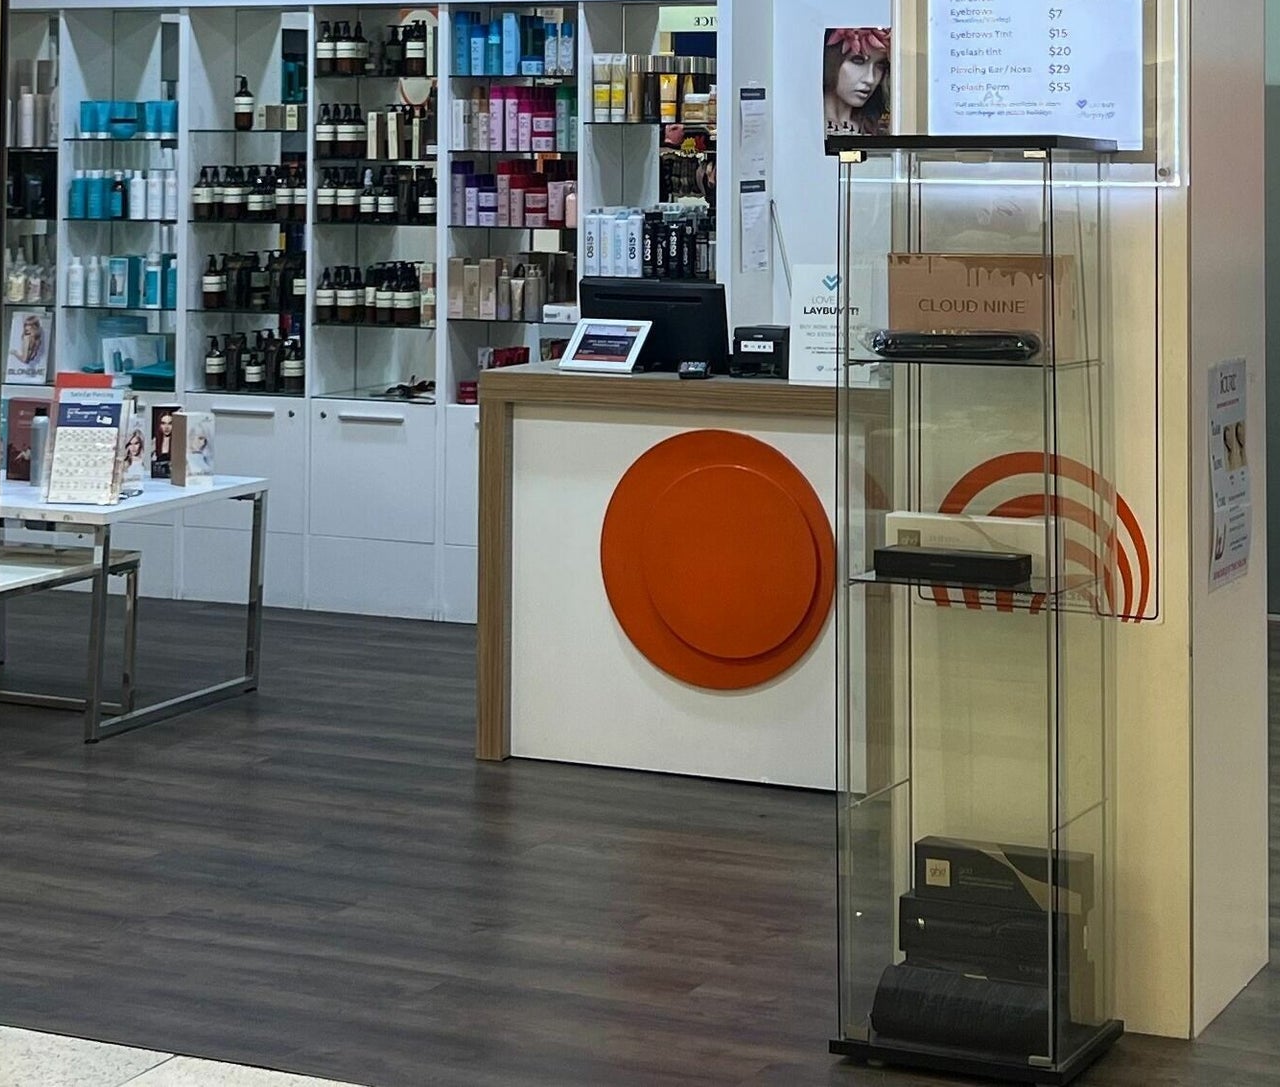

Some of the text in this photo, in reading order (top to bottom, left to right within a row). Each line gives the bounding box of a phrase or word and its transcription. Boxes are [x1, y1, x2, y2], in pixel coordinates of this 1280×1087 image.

[1048, 7, 1063, 20] $7
[950, 31, 993, 40] Eyebrows
[1048, 28, 1068, 39] $15
[950, 48, 984, 57] Eyelash
[1048, 45, 1072, 57] $20
[1048, 64, 1071, 74] $29
[1048, 81, 1071, 93] $55
[811, 296, 835, 305] LOVE
[918, 298, 1026, 314] CLOUD NINE
[803, 306, 846, 315] LAYBUY
